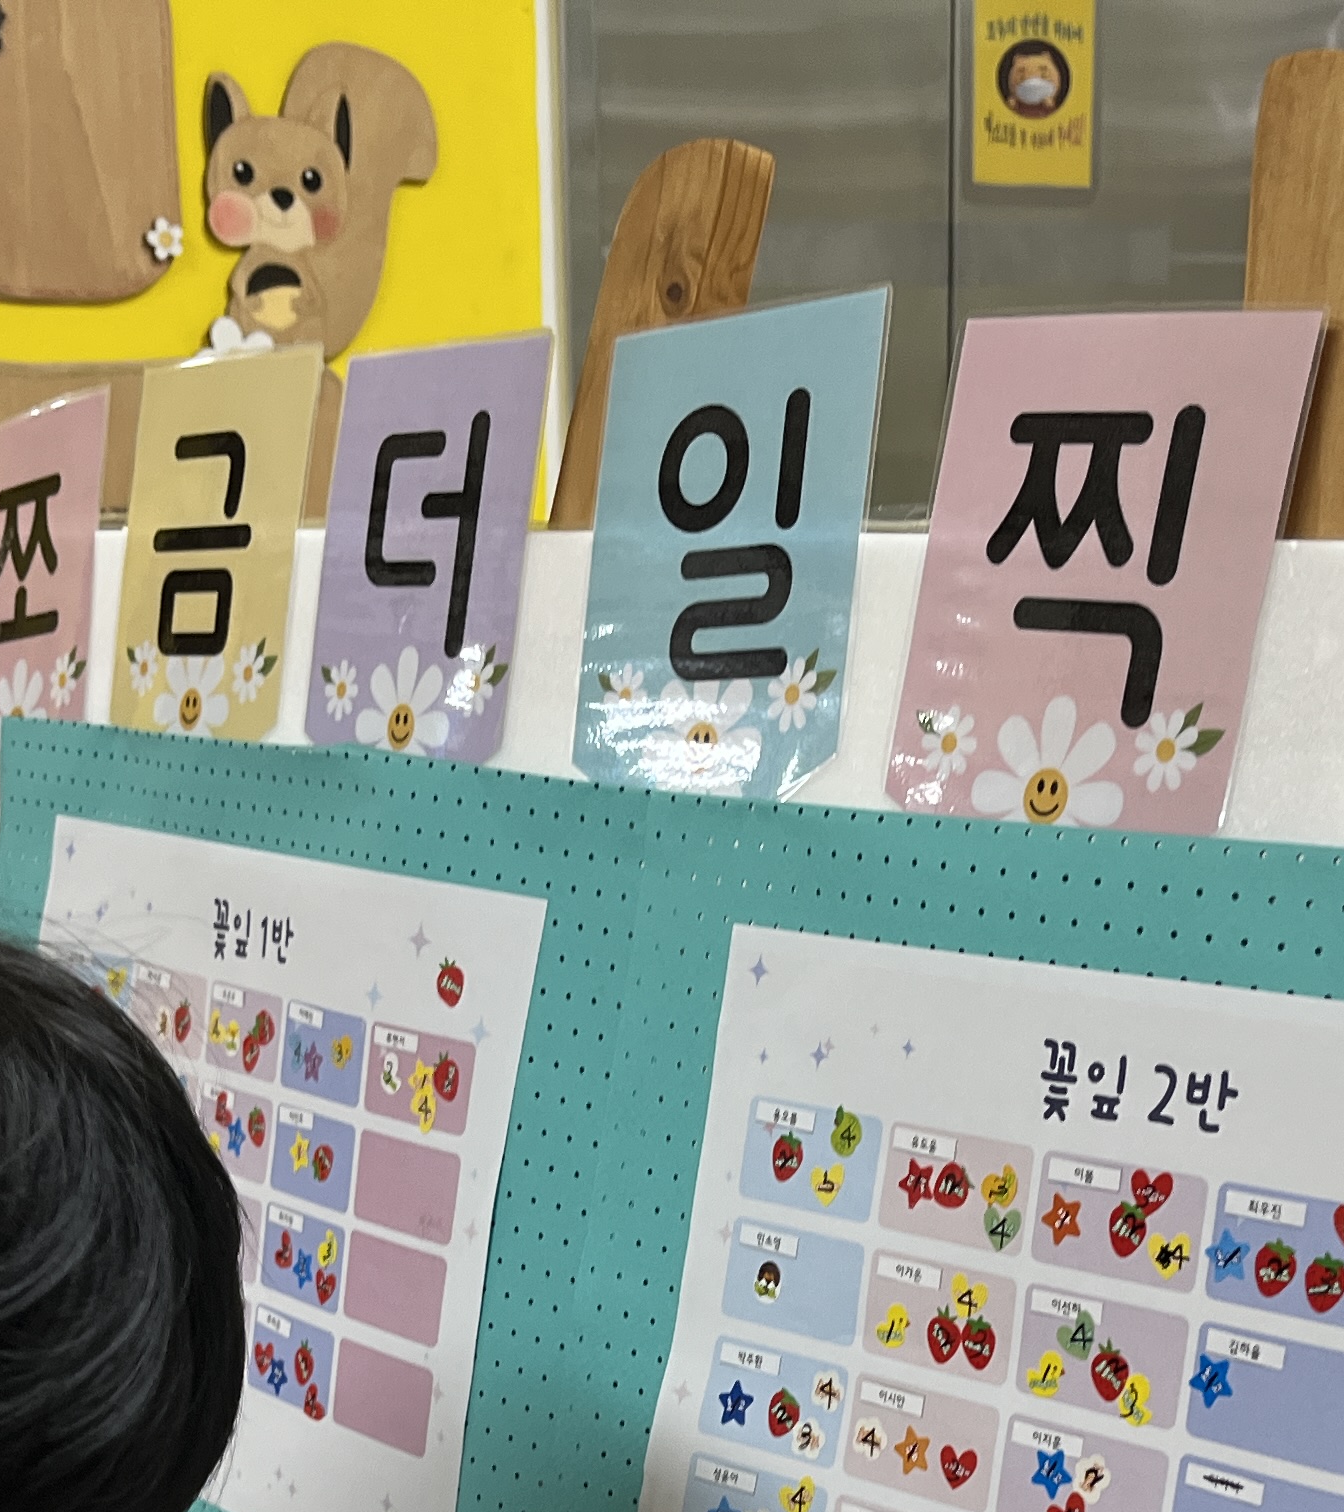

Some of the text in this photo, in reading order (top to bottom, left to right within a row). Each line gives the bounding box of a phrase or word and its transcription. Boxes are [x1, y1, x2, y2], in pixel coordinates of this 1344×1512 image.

[364, 410, 492, 659] 더
[213, 897, 295, 964] 꽃잎 1반
[1040, 1038, 1239, 1134] 꽃잎 2반
[989, 1217, 1011, 1250] 4
[957, 1289, 978, 1318] 4
[1069, 1323, 1094, 1351] 4
[820, 1377, 841, 1410] 4
[860, 1428, 881, 1457] 4
